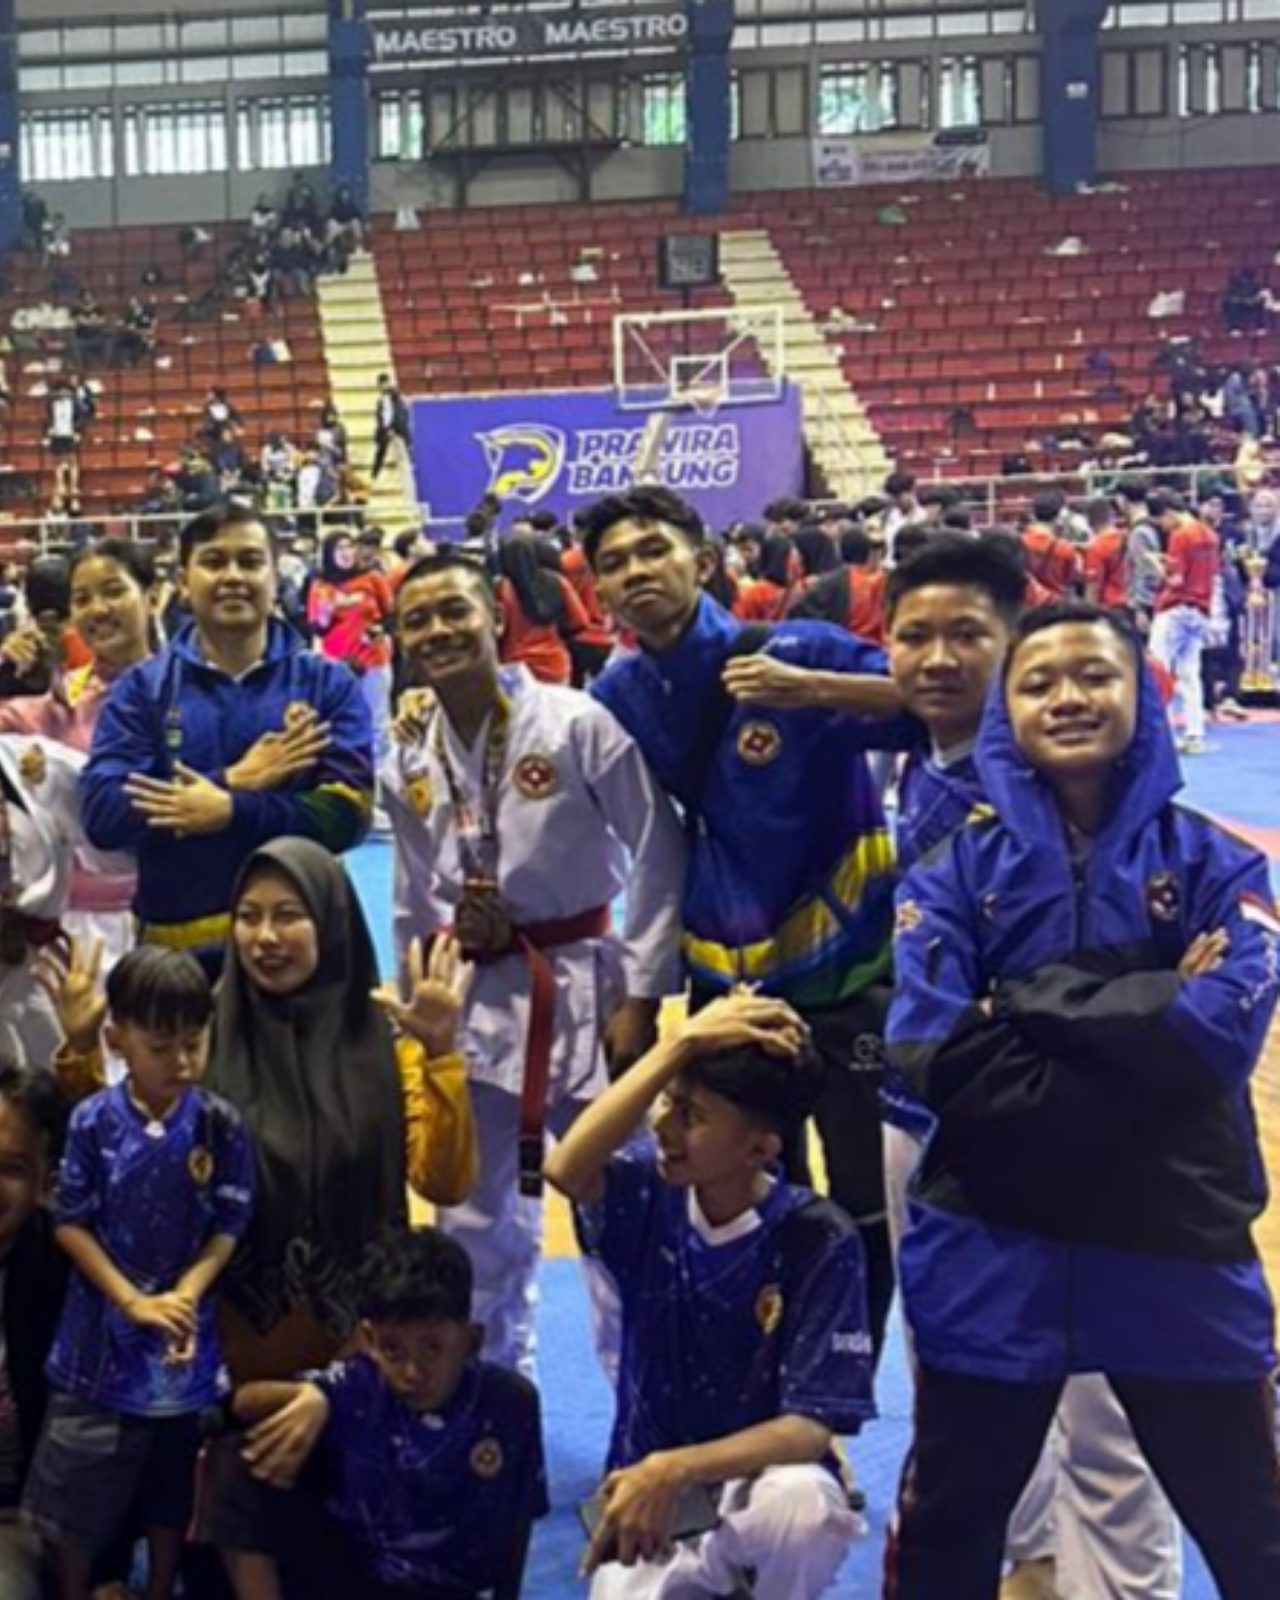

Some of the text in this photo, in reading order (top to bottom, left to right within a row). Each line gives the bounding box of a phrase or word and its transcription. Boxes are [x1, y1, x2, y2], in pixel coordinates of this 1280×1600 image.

[375, 13, 687, 53] MAESTRO MAESTRO
[570, 458, 733, 489] BANUNG
